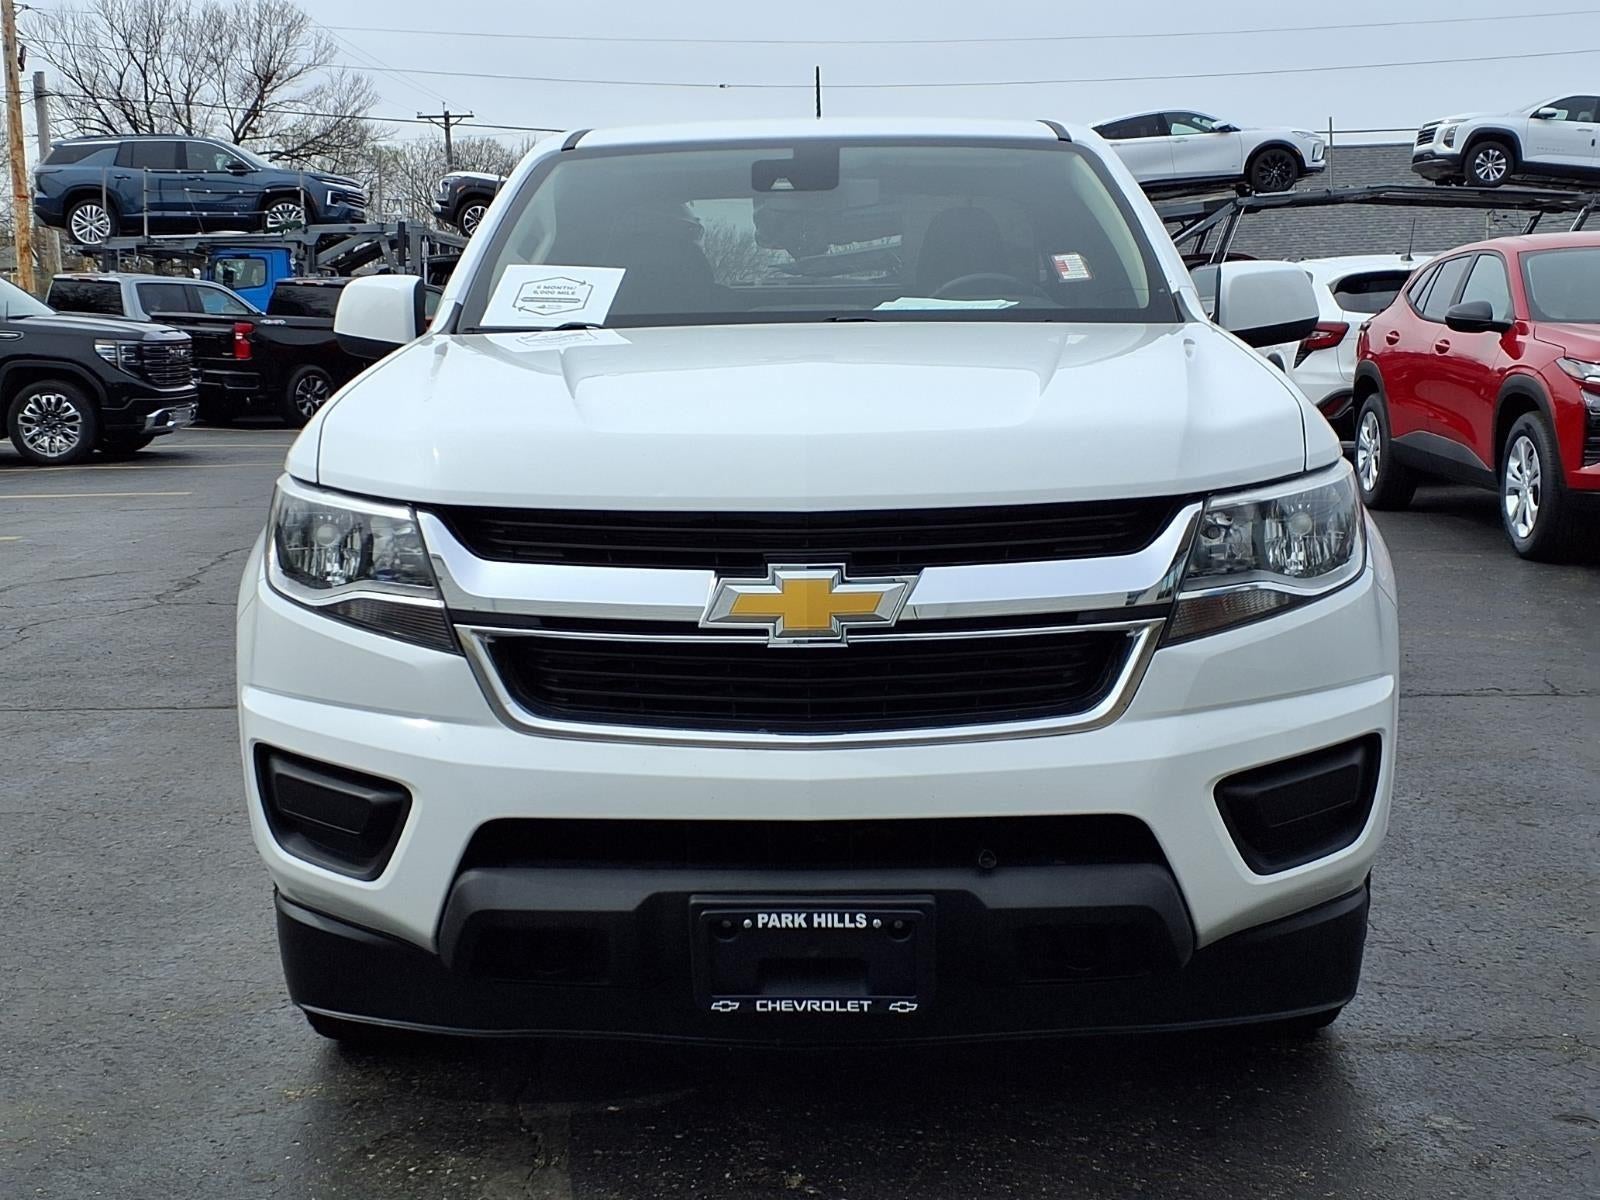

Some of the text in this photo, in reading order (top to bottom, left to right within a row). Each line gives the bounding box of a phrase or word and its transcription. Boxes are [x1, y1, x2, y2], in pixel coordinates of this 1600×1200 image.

[757, 913, 867, 929] PARK HILLS
[755, 1000, 872, 1012] CHEVROLET
